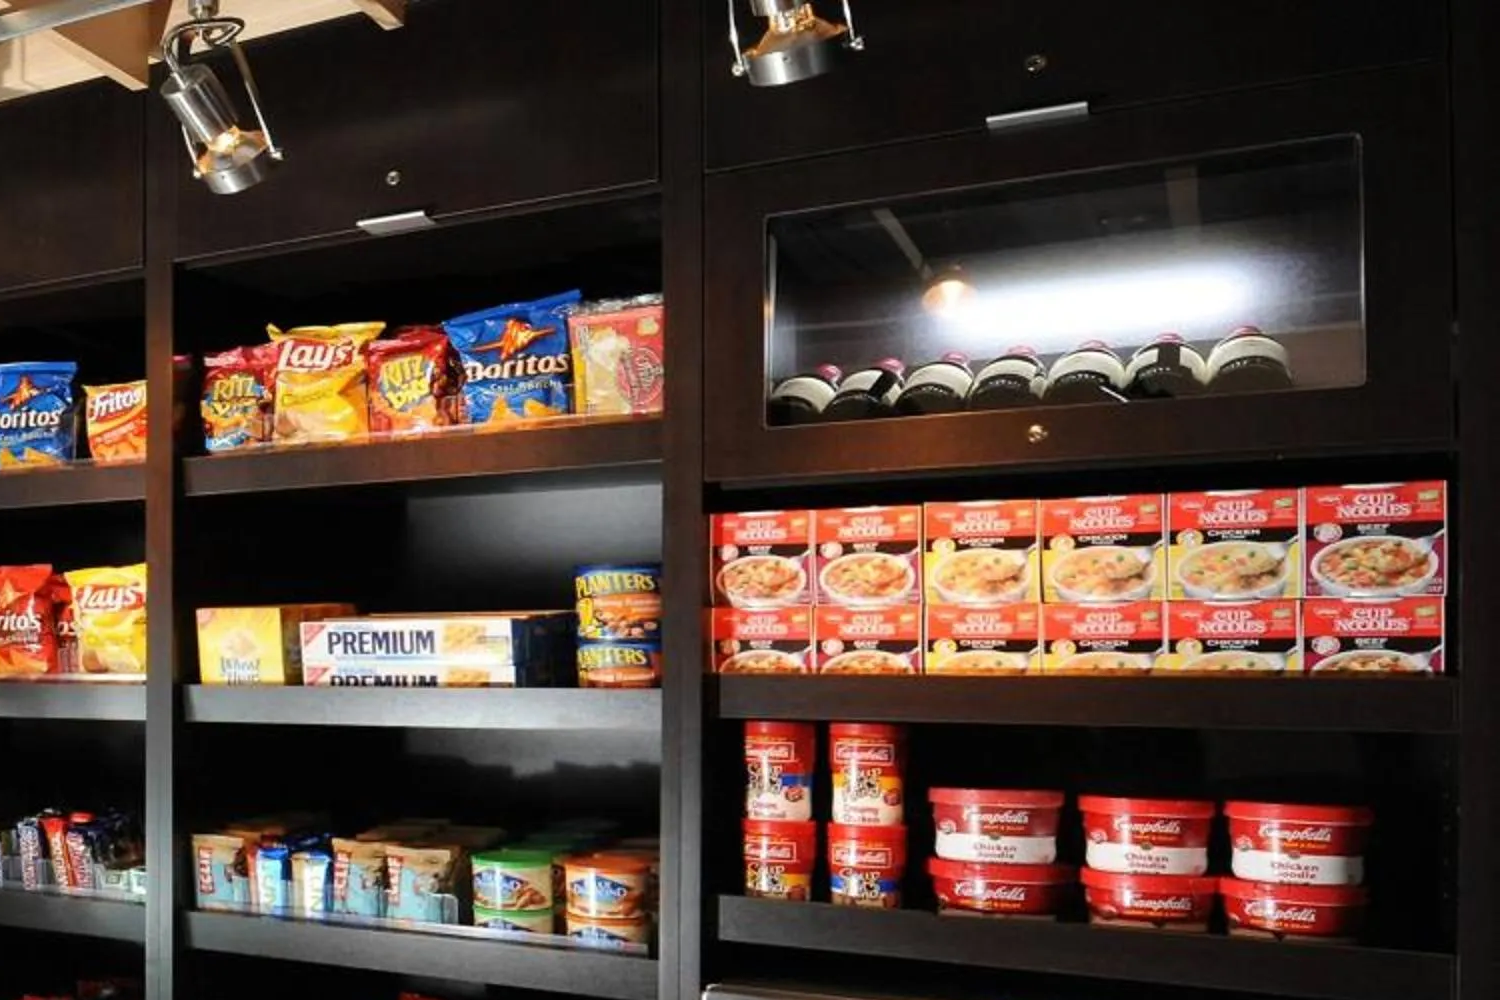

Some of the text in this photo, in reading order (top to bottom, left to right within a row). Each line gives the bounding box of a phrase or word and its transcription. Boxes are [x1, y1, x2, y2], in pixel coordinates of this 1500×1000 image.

[465, 353, 570, 382] Doritos
[213, 375, 255, 399] RITZ
[90, 387, 146, 421] Fritos
[1355, 492, 1396, 506] CUP
[1084, 506, 1122, 518] CUP
[1214, 500, 1254, 513] CUP
[1337, 502, 1413, 518] NOODLES
[1069, 515, 1135, 530] NOODLES
[1198, 510, 1267, 524] NOODLES
[1207, 529, 1260, 537] CHICKEN
[1357, 523, 1390, 531] BEEF
[576, 574, 656, 597] PLANTERS
[1085, 612, 1123, 623] CUP
[1213, 610, 1252, 622] CUP
[1352, 607, 1393, 619] CUP
[1070, 621, 1136, 635] NOODLES
[1196, 620, 1266, 634] NOODLES
[1333, 617, 1411, 632] NOODLES
[327, 630, 436, 655] PREMIUM
[1125, 853, 1169, 863] Chicken
[1271, 861, 1319, 872] Chicken
